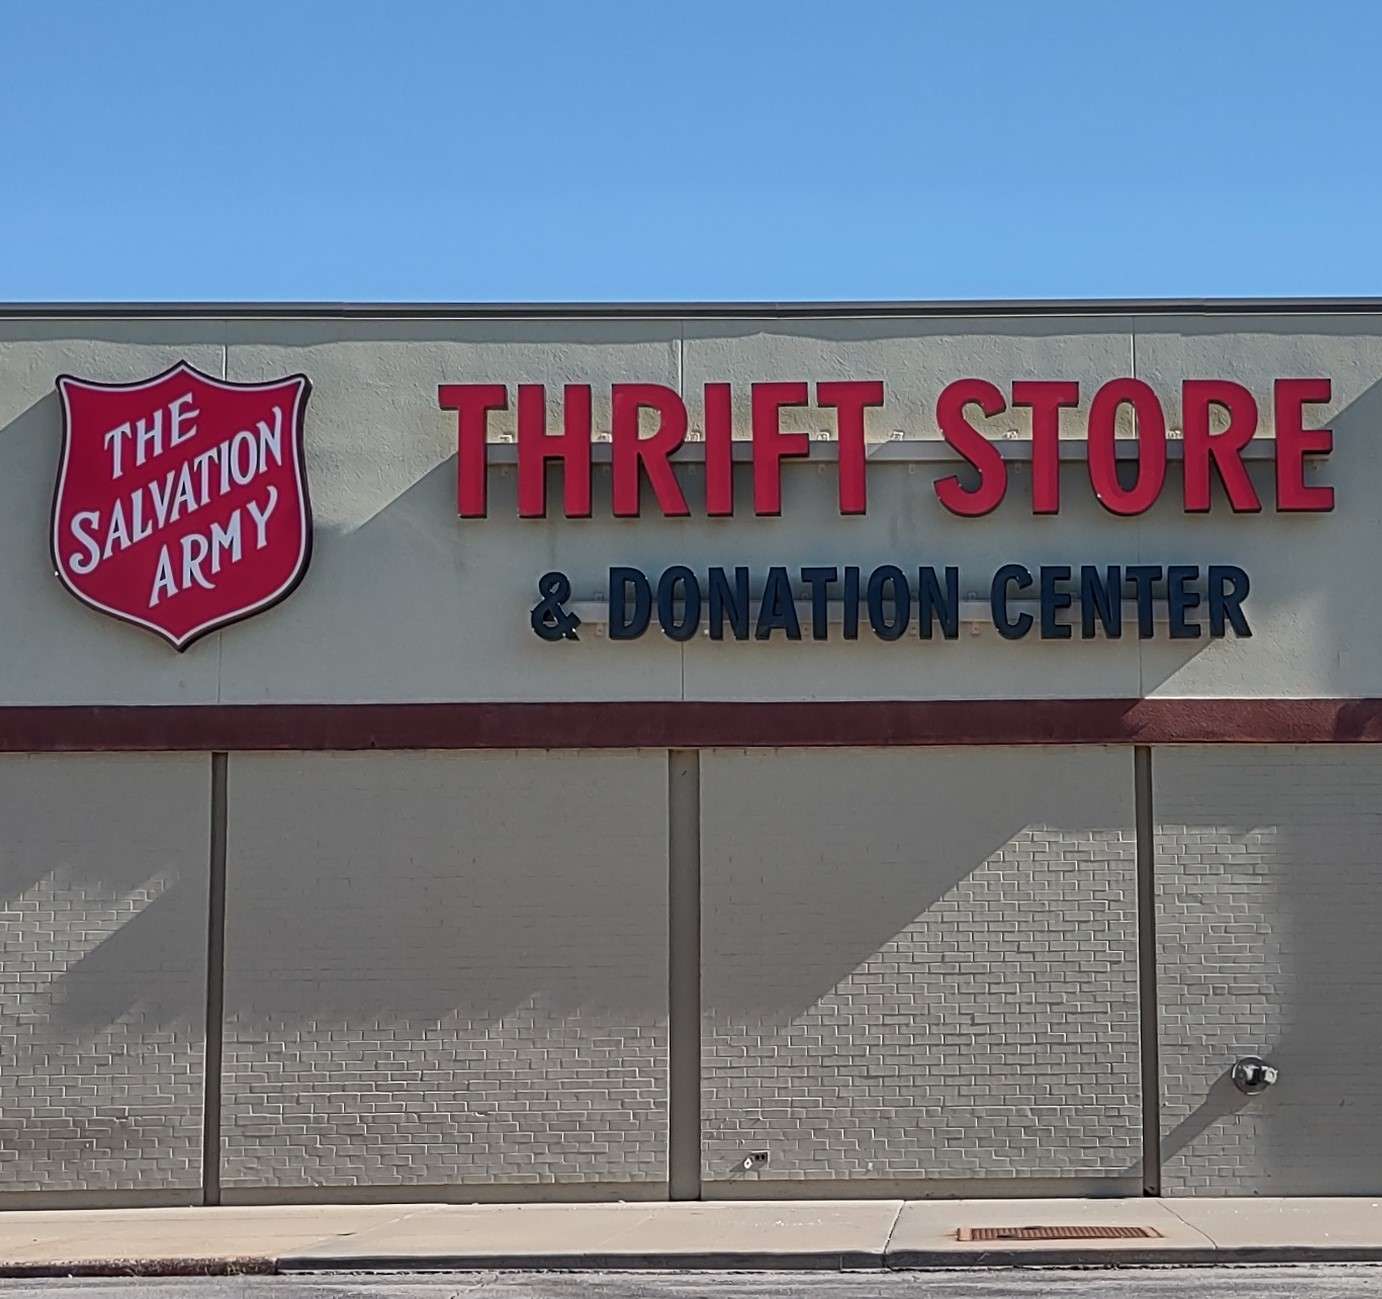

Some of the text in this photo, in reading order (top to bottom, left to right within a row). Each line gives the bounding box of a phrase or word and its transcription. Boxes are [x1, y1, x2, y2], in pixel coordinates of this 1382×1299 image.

[69, 405, 283, 576] SALVATION
[104, 392, 200, 480] THE
[437, 377, 1336, 519] THRIFT STORE
[148, 485, 279, 609] ARMY
[530, 563, 1253, 642] & DONATION CENTER
